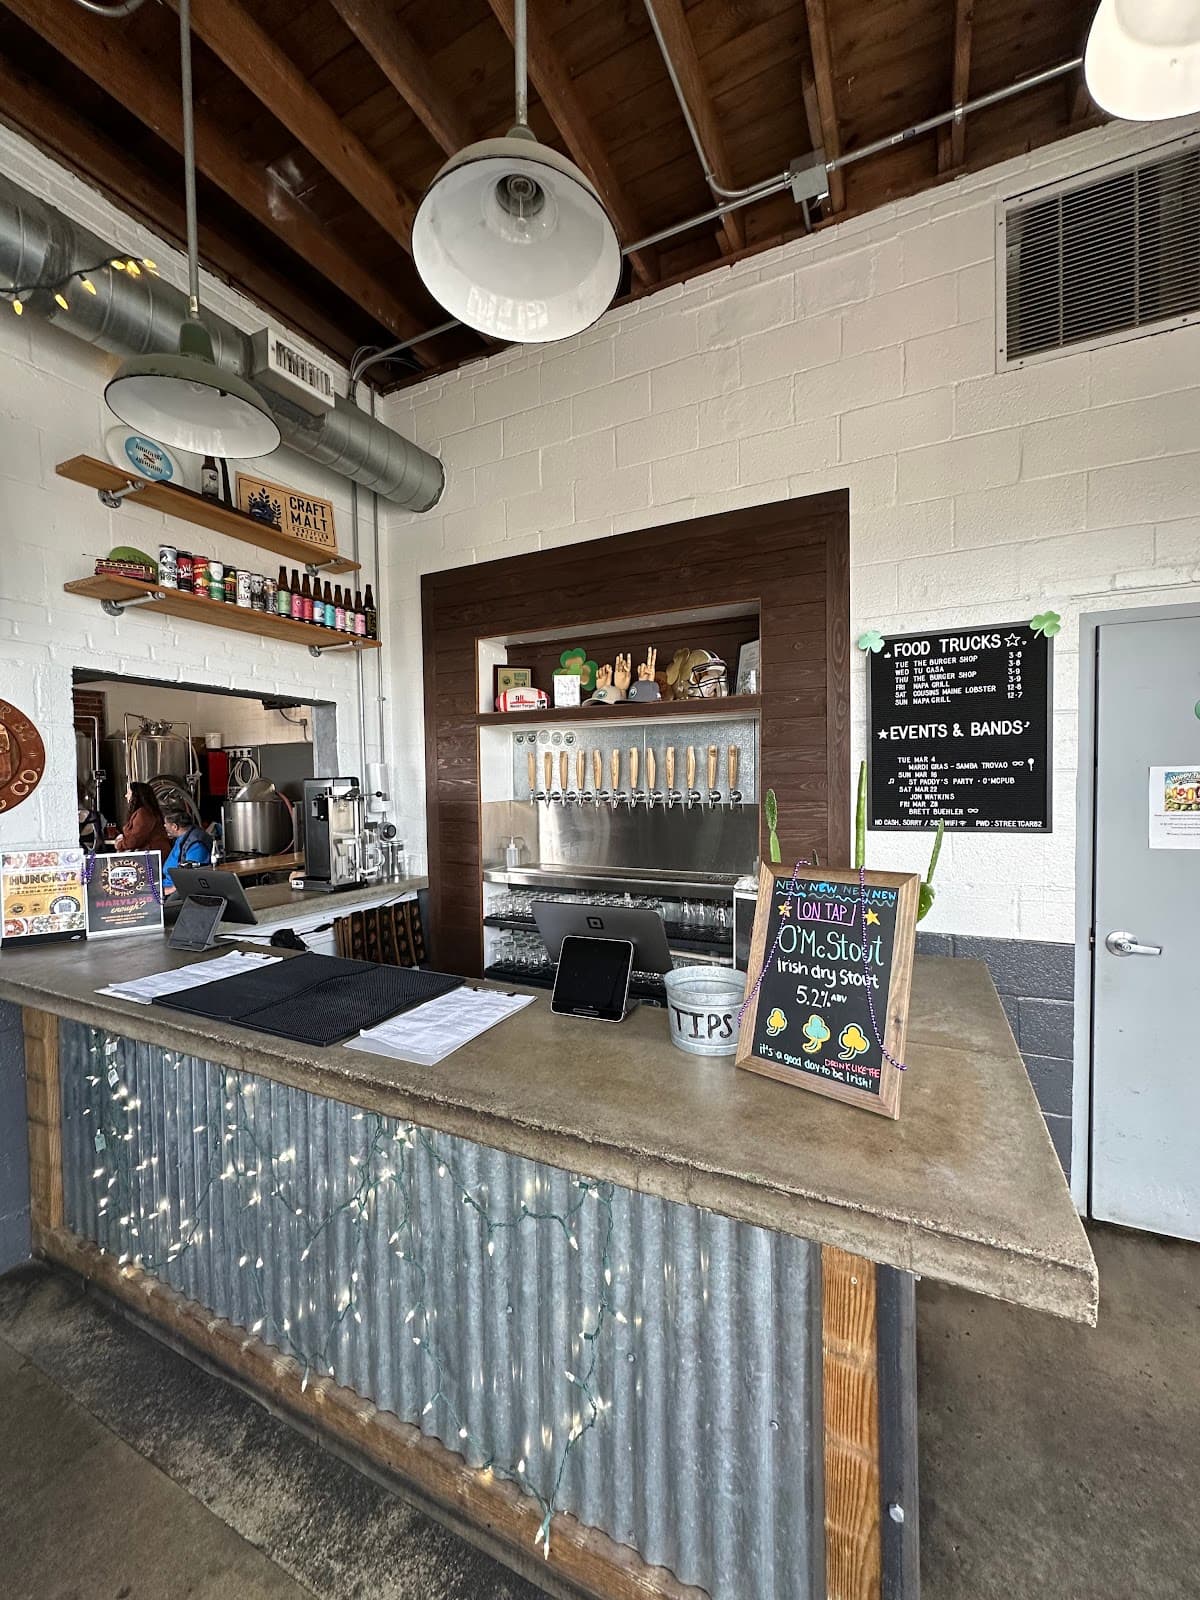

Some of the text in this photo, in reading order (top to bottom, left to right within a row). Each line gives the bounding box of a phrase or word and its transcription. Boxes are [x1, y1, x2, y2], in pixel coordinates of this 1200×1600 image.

[290, 496, 325, 518] CRAFT
[291, 510, 327, 531] MALT
[894, 634, 1002, 658] FOOD TRUCKS
[895, 661, 908, 669] TUE
[929, 656, 956, 666] BURGER
[960, 655, 978, 663] SHOP
[895, 668, 910, 676] WED
[930, 672, 956, 681] BURGER
[912, 689, 940, 697] COUSINS
[942, 687, 962, 695] MAINE
[965, 685, 996, 693] LOBSTER
[931, 696, 951, 704] GRILL
[890, 720, 1023, 740] EVENTS & BANDS
[9, 872, 77, 886] HUNGRY?
[776, 880, 896, 900] NEW NEW NEW NEW
[96, 896, 153, 908] MARYLAND
[802, 902, 848, 921] ON TAP
[777, 958, 808, 976] Irish
[811, 964, 837, 988] dry
[796, 986, 848, 1008] 5.2% ABV
[671, 1004, 732, 1039] TIPS
[759, 1043, 872, 1089] it's a good day to be Irish!
[825, 1059, 850, 1072] DRINK
[851, 1064, 866, 1075] LIKE
